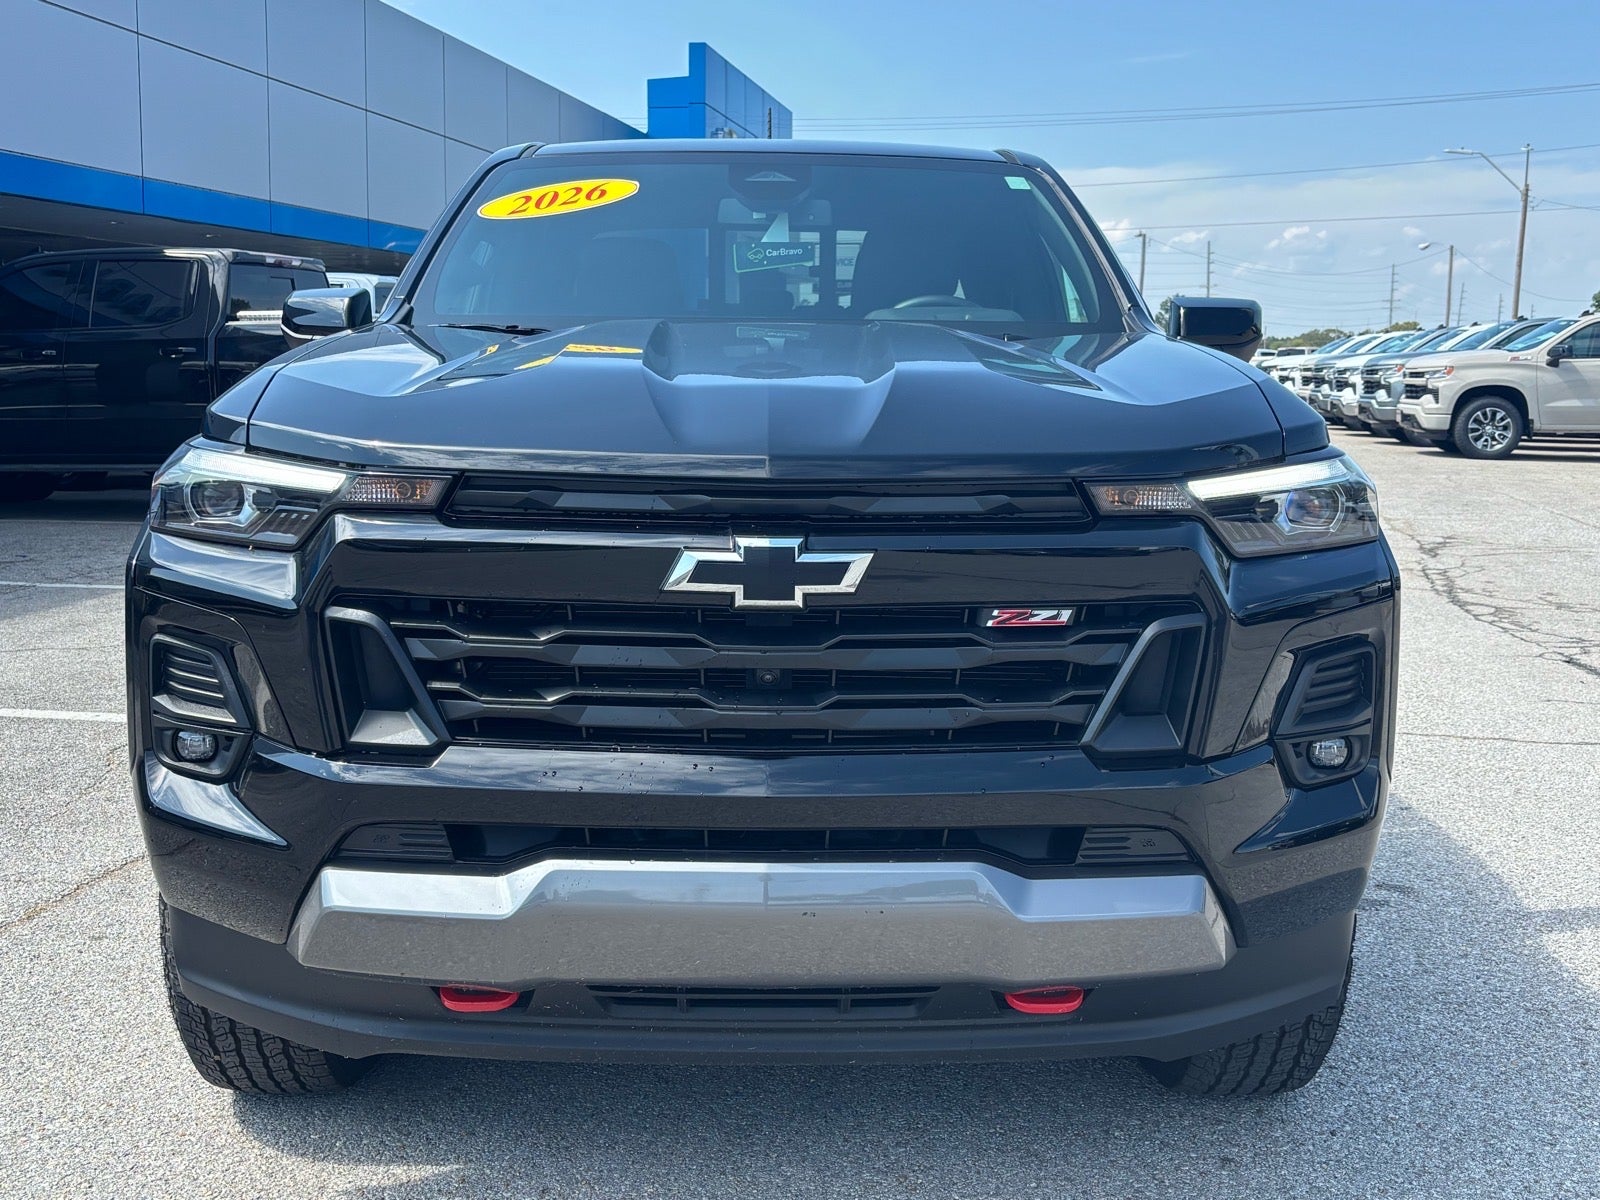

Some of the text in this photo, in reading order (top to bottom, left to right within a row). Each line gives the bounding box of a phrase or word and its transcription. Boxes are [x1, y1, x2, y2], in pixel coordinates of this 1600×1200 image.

[506, 182, 611, 216] 2026
[765, 247, 803, 257] CarBravo
[985, 609, 1073, 627] Z71
